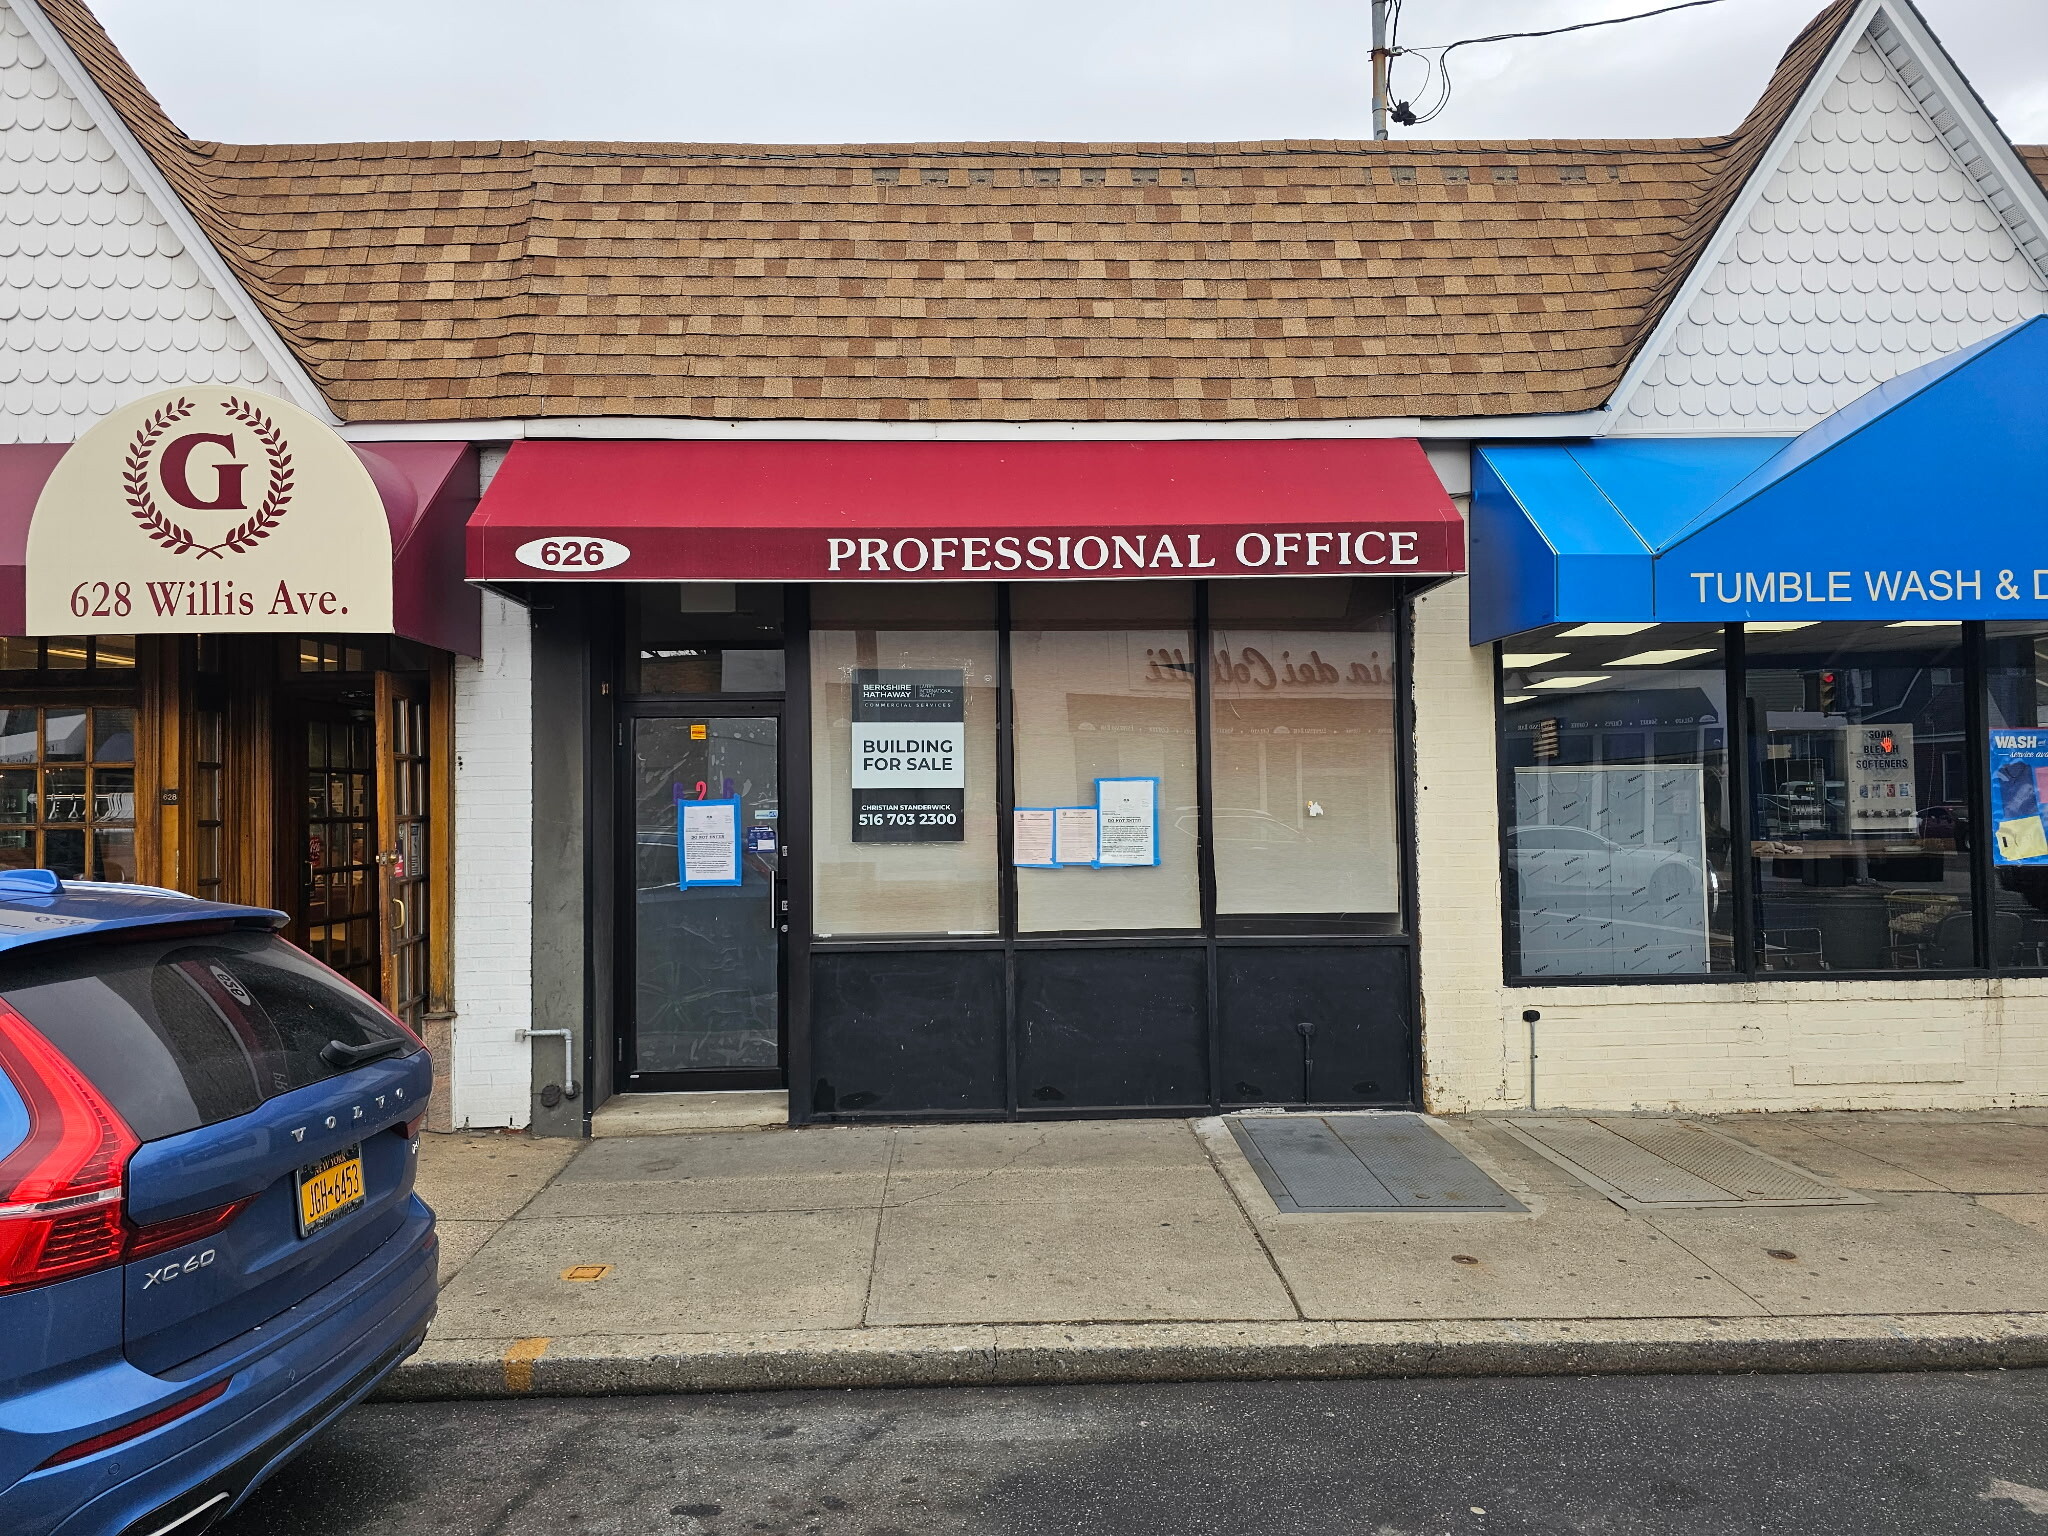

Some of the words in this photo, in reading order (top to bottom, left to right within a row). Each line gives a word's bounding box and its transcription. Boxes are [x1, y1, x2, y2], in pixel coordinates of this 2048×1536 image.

[159, 432, 249, 510] G
[540, 541, 605, 566] 626
[827, 534, 1216, 572] PROFESSIONAL
[1235, 531, 1420, 567] OFFICE
[1690, 571, 1852, 603] TUMBLE
[1864, 569, 1981, 601] WASH
[1995, 569, 2021, 600] &
[70, 581, 132, 617] 628
[145, 579, 255, 616] Willis
[267, 580, 349, 616] Ave.
[1868, 730, 1893, 739] SOAP
[1994, 735, 2037, 749] WASH
[863, 739, 953, 753] BUILDING
[1863, 745, 1899, 754] BLEAH
[863, 757, 902, 771] FOR
[906, 757, 953, 771] SALE
[1856, 759, 1909, 769] SOFTENERS
[858, 813, 884, 826] 516
[886, 813, 916, 826] 703
[918, 813, 957, 826] 2300
[290, 1088, 405, 1142] VOLVO
[143, 1249, 216, 1290] XC60
